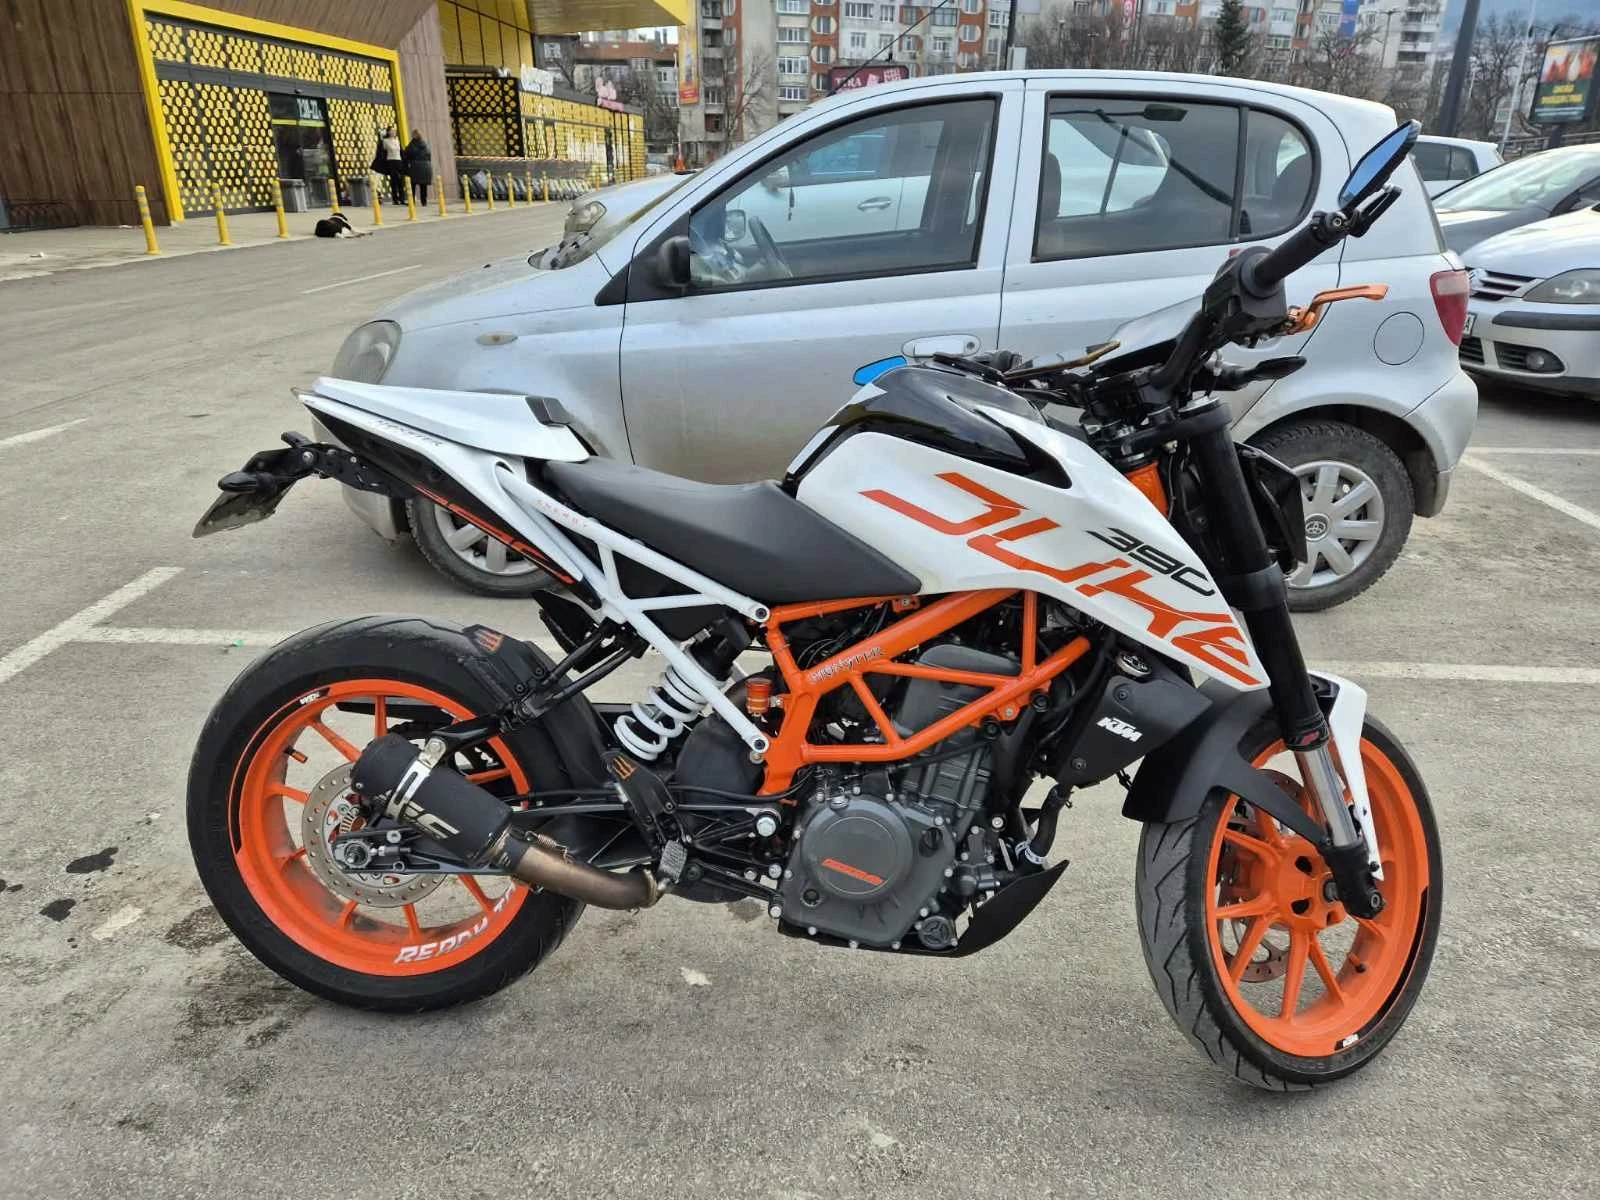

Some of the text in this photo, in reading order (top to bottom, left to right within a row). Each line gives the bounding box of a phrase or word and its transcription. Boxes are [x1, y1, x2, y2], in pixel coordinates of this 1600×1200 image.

[858, 471, 1262, 687] DUKE
[1086, 526, 1216, 597] 390
[1096, 716, 1143, 743] KTM
